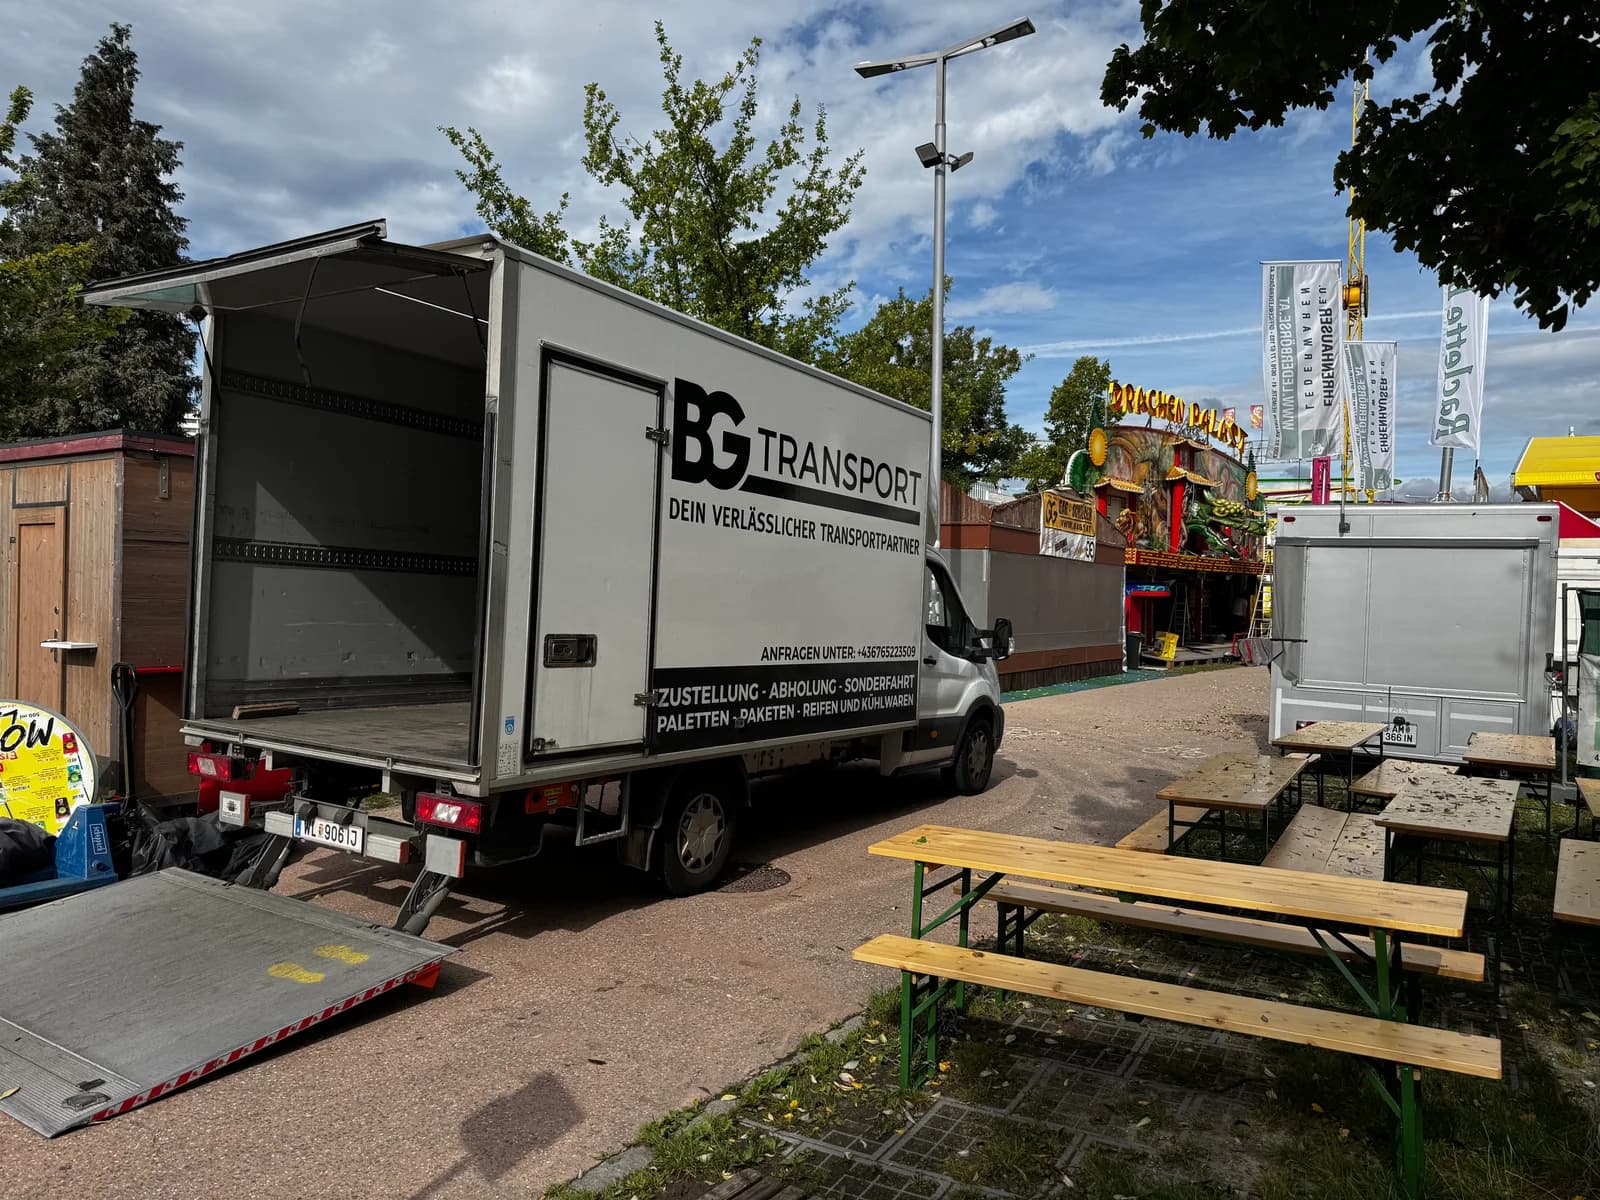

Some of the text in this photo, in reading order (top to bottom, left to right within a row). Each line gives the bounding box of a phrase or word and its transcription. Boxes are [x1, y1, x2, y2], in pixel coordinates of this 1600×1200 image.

[1109, 382, 1185, 424] DRACHEN
[1189, 402, 1249, 454] PALAST
[671, 376, 922, 506] BG TRANSPORT
[669, 497, 920, 556] DEIN VERLÄSSLICHER TRANSPORTPARTNER
[760, 646, 821, 661] ANFRAGEN
[822, 645, 856, 659] UNTER:
[658, 683, 759, 708] ZUSTELLUNG
[769, 678, 837, 699] ABHOLUNG
[844, 674, 915, 693] SONDERFAHRT
[656, 710, 730, 733] PALETTEN
[740, 704, 795, 724] PAKETEN
[802, 699, 839, 718] REIFEN
[840, 697, 860, 713] UND
[861, 693, 914, 711] KÜHLWAREN
[1385, 732, 1402, 742] 366
